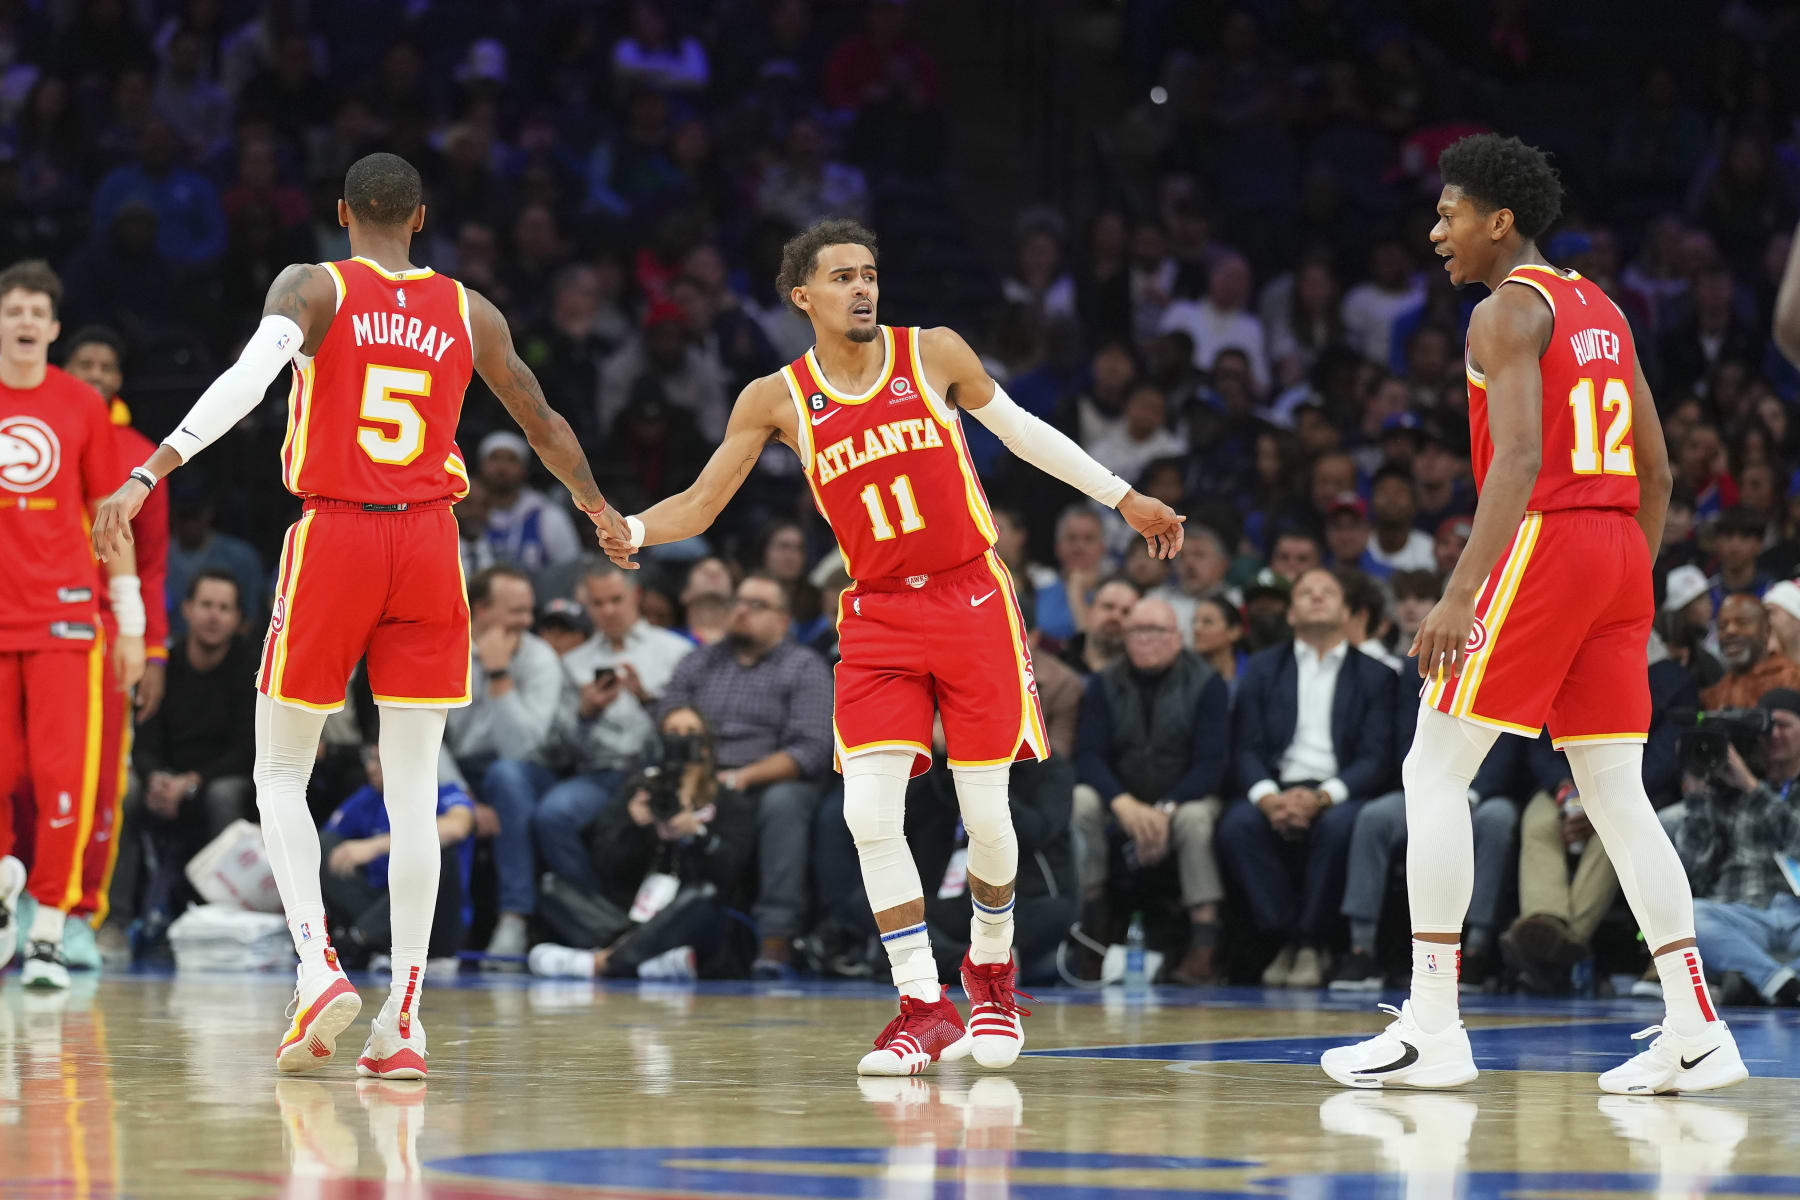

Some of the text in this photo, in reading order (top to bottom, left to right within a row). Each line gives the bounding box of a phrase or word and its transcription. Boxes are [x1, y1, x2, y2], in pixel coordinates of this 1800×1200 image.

[352, 312, 455, 362] MURRAY
[1570, 328, 1620, 366] HUNTER
[357, 363, 432, 466] 5
[811, 394, 824, 410] 6
[1569, 378, 1637, 476] 12
[816, 417, 944, 486] ATLANTA
[860, 474, 926, 541] 11
